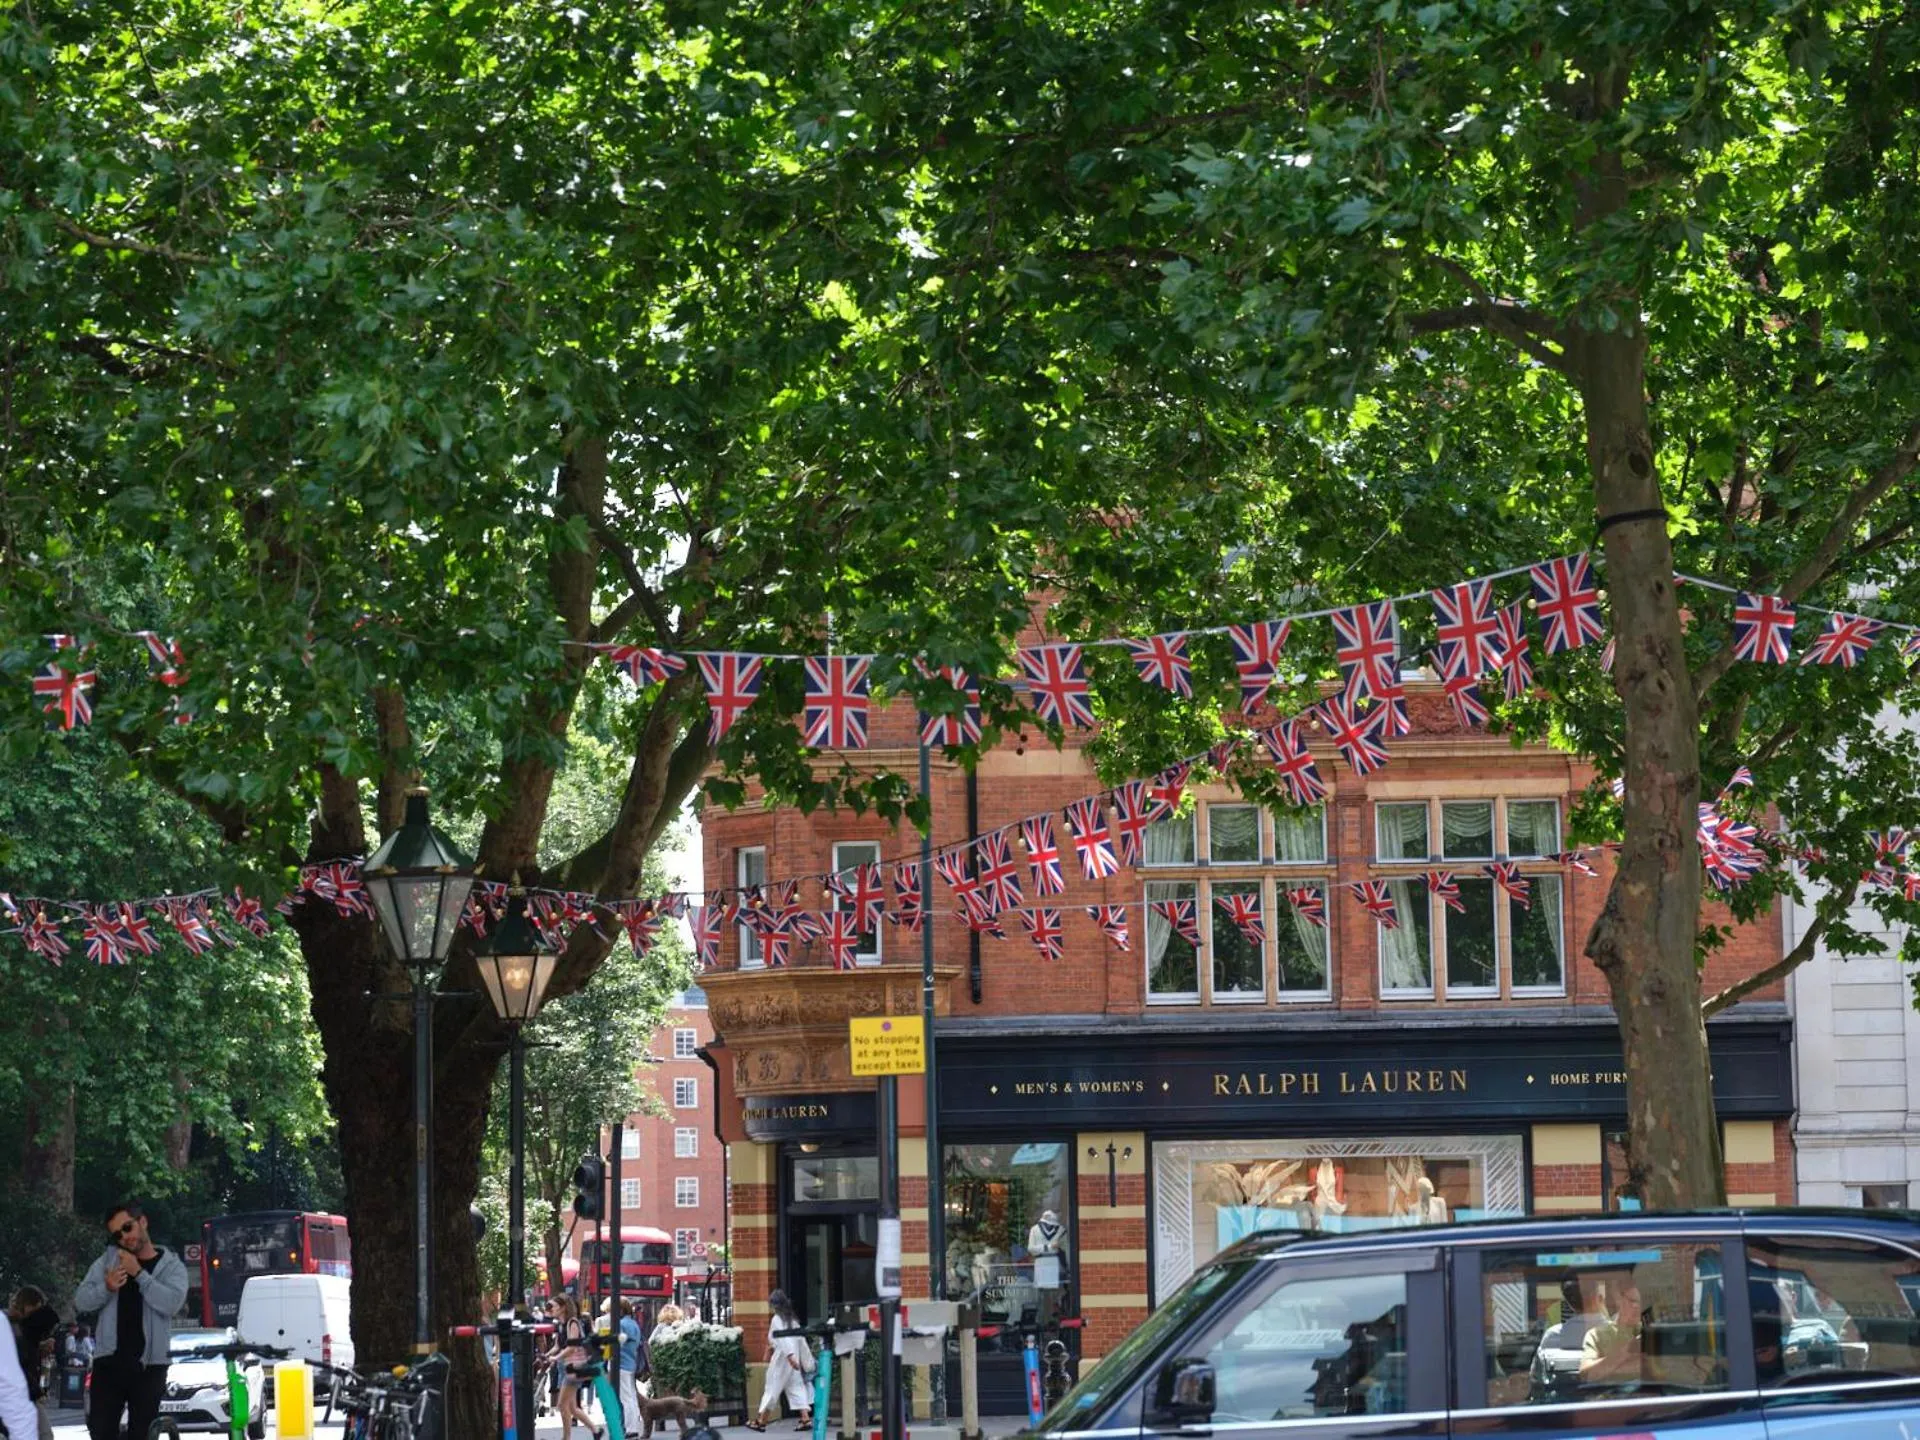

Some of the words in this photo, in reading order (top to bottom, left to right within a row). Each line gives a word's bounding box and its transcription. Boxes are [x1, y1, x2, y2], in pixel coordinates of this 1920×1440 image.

[855, 1036, 870, 1045] No
[874, 1035, 920, 1046] stopping
[857, 1049, 868, 1058] at
[873, 1050, 890, 1059] any
[895, 1048, 918, 1056] time
[856, 1061, 891, 1071] except
[895, 1060, 921, 1069] taxis
[1213, 1072, 1322, 1096] RALPH
[1339, 1069, 1468, 1094] LAUREN
[1550, 1073, 1590, 1085] HOME
[1015, 1082, 1058, 1095] MEN'S
[1063, 1082, 1073, 1093] &
[1079, 1080, 1144, 1093] WOMEN'S
[772, 1104, 829, 1119] LAUREN
